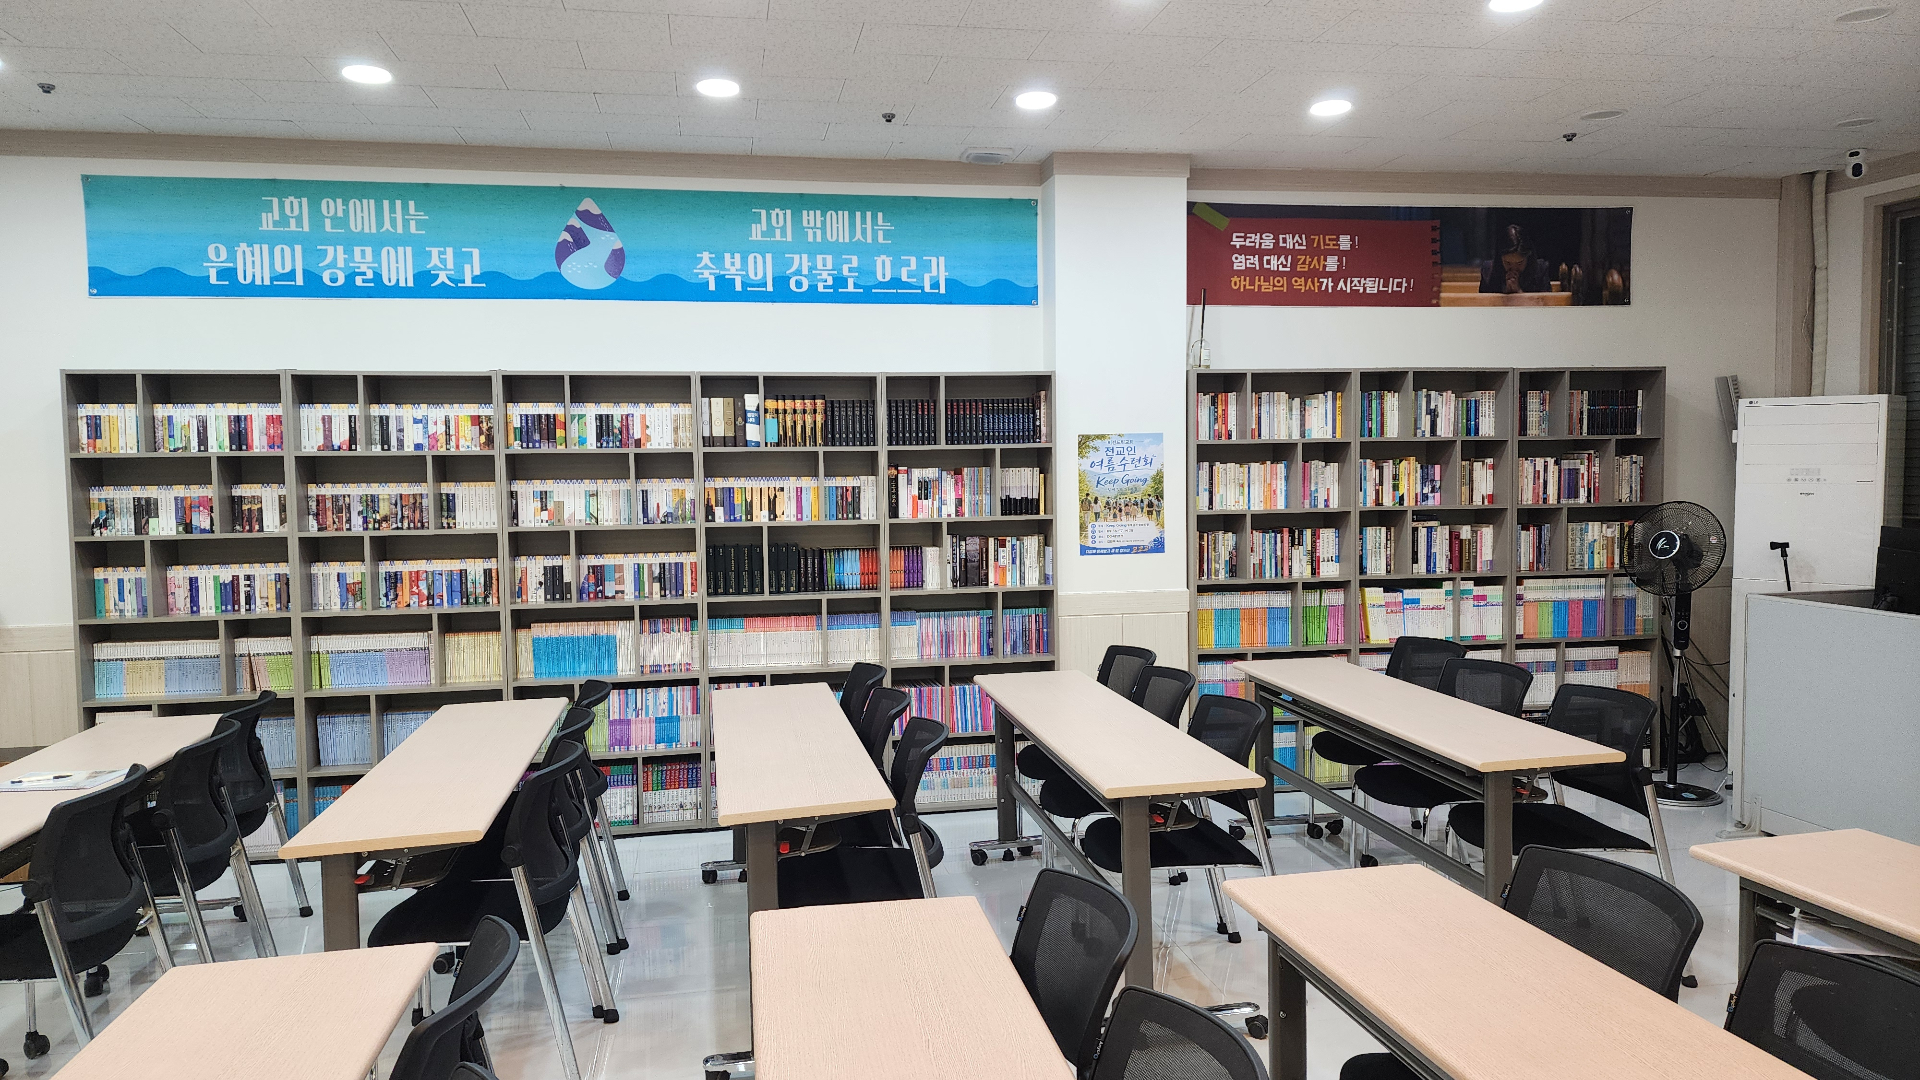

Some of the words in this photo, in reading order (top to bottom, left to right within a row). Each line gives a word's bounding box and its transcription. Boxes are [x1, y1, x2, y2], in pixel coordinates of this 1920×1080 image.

[259, 196, 309, 232] 교회
[321, 197, 429, 234] 안에서는
[749, 208, 792, 242] 교회
[802, 209, 895, 244] 밖에서는
[1230, 232, 1276, 250] 두려움
[1279, 233, 1306, 251] 대신
[203, 242, 304, 287] 은혜의
[317, 244, 415, 288] 강물에
[425, 246, 487, 288] 젖고
[1232, 254, 1260, 271] 염려
[1263, 254, 1292, 272] 대신
[693, 251, 773, 293] 축복의
[785, 253, 864, 293] 강물로
[871, 255, 948, 295] 흐르라
[1230, 275, 1288, 294] 하나님의
[1291, 276, 1334, 294] 역사가
[1105, 445, 1136, 457] 전교인
[1096, 476, 1119, 489] Keep
[1121, 474, 1149, 487] Going
